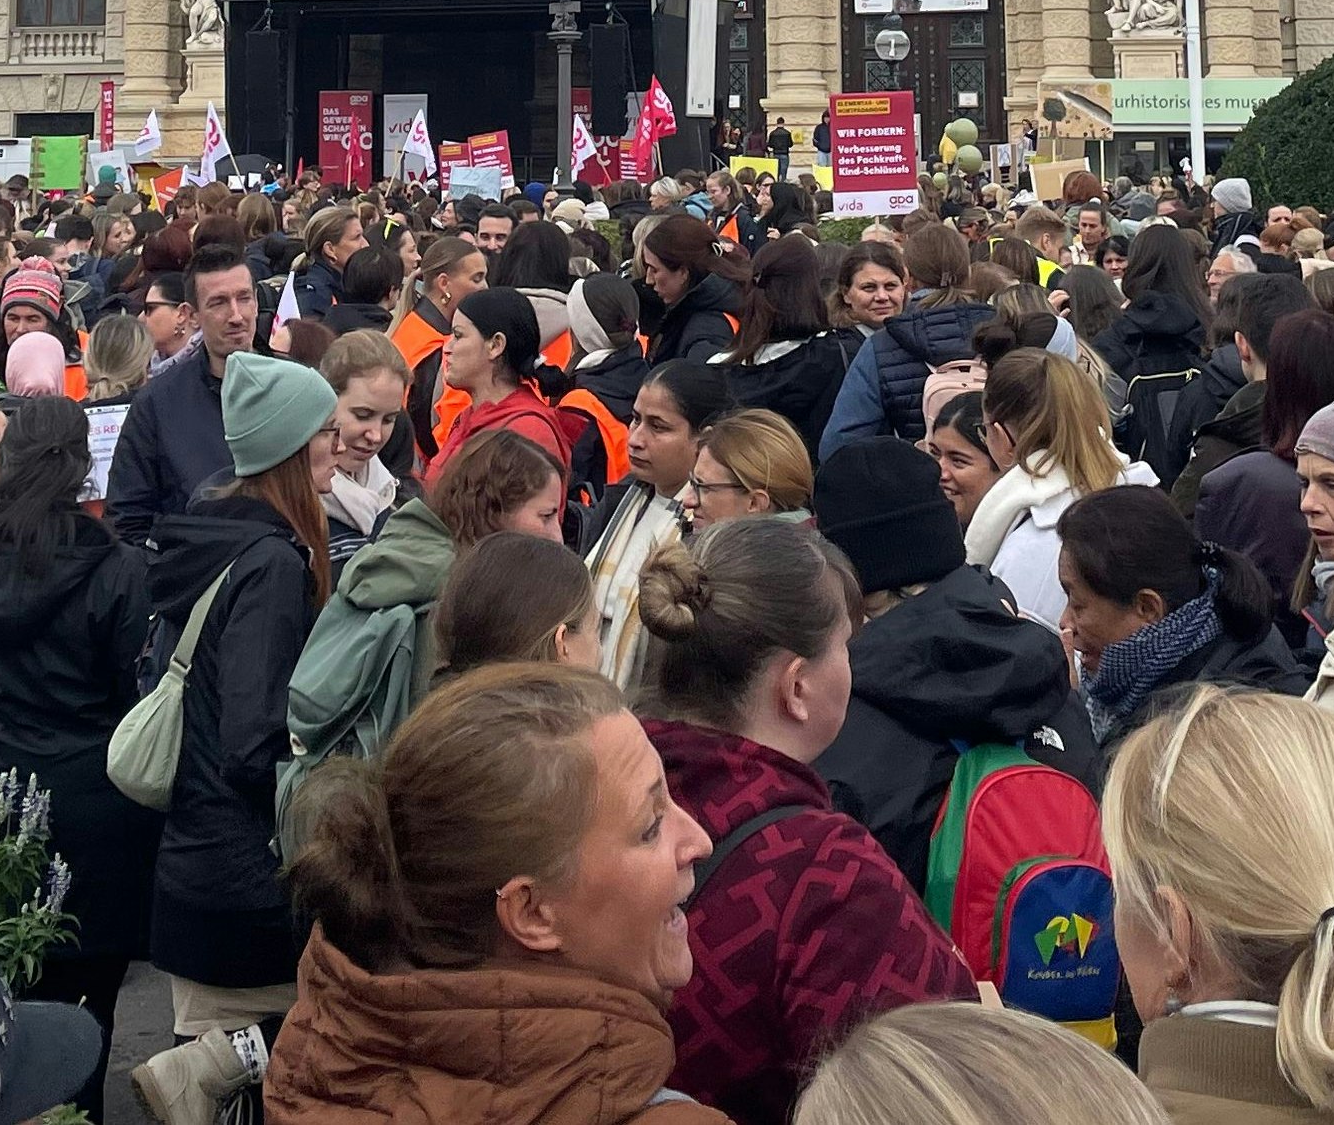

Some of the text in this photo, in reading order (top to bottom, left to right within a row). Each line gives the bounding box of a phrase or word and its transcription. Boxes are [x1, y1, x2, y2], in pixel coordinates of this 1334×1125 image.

[322, 108, 340, 116] DAS
[573, 104, 588, 112] DAS
[836, 126, 907, 138] WIR FORDERN:
[837, 144, 902, 154] Verbesserung
[838, 154, 907, 165] des Fachkraft-
[838, 165, 910, 176] Kind-Schlüssels
[838, 199, 864, 212] vida
